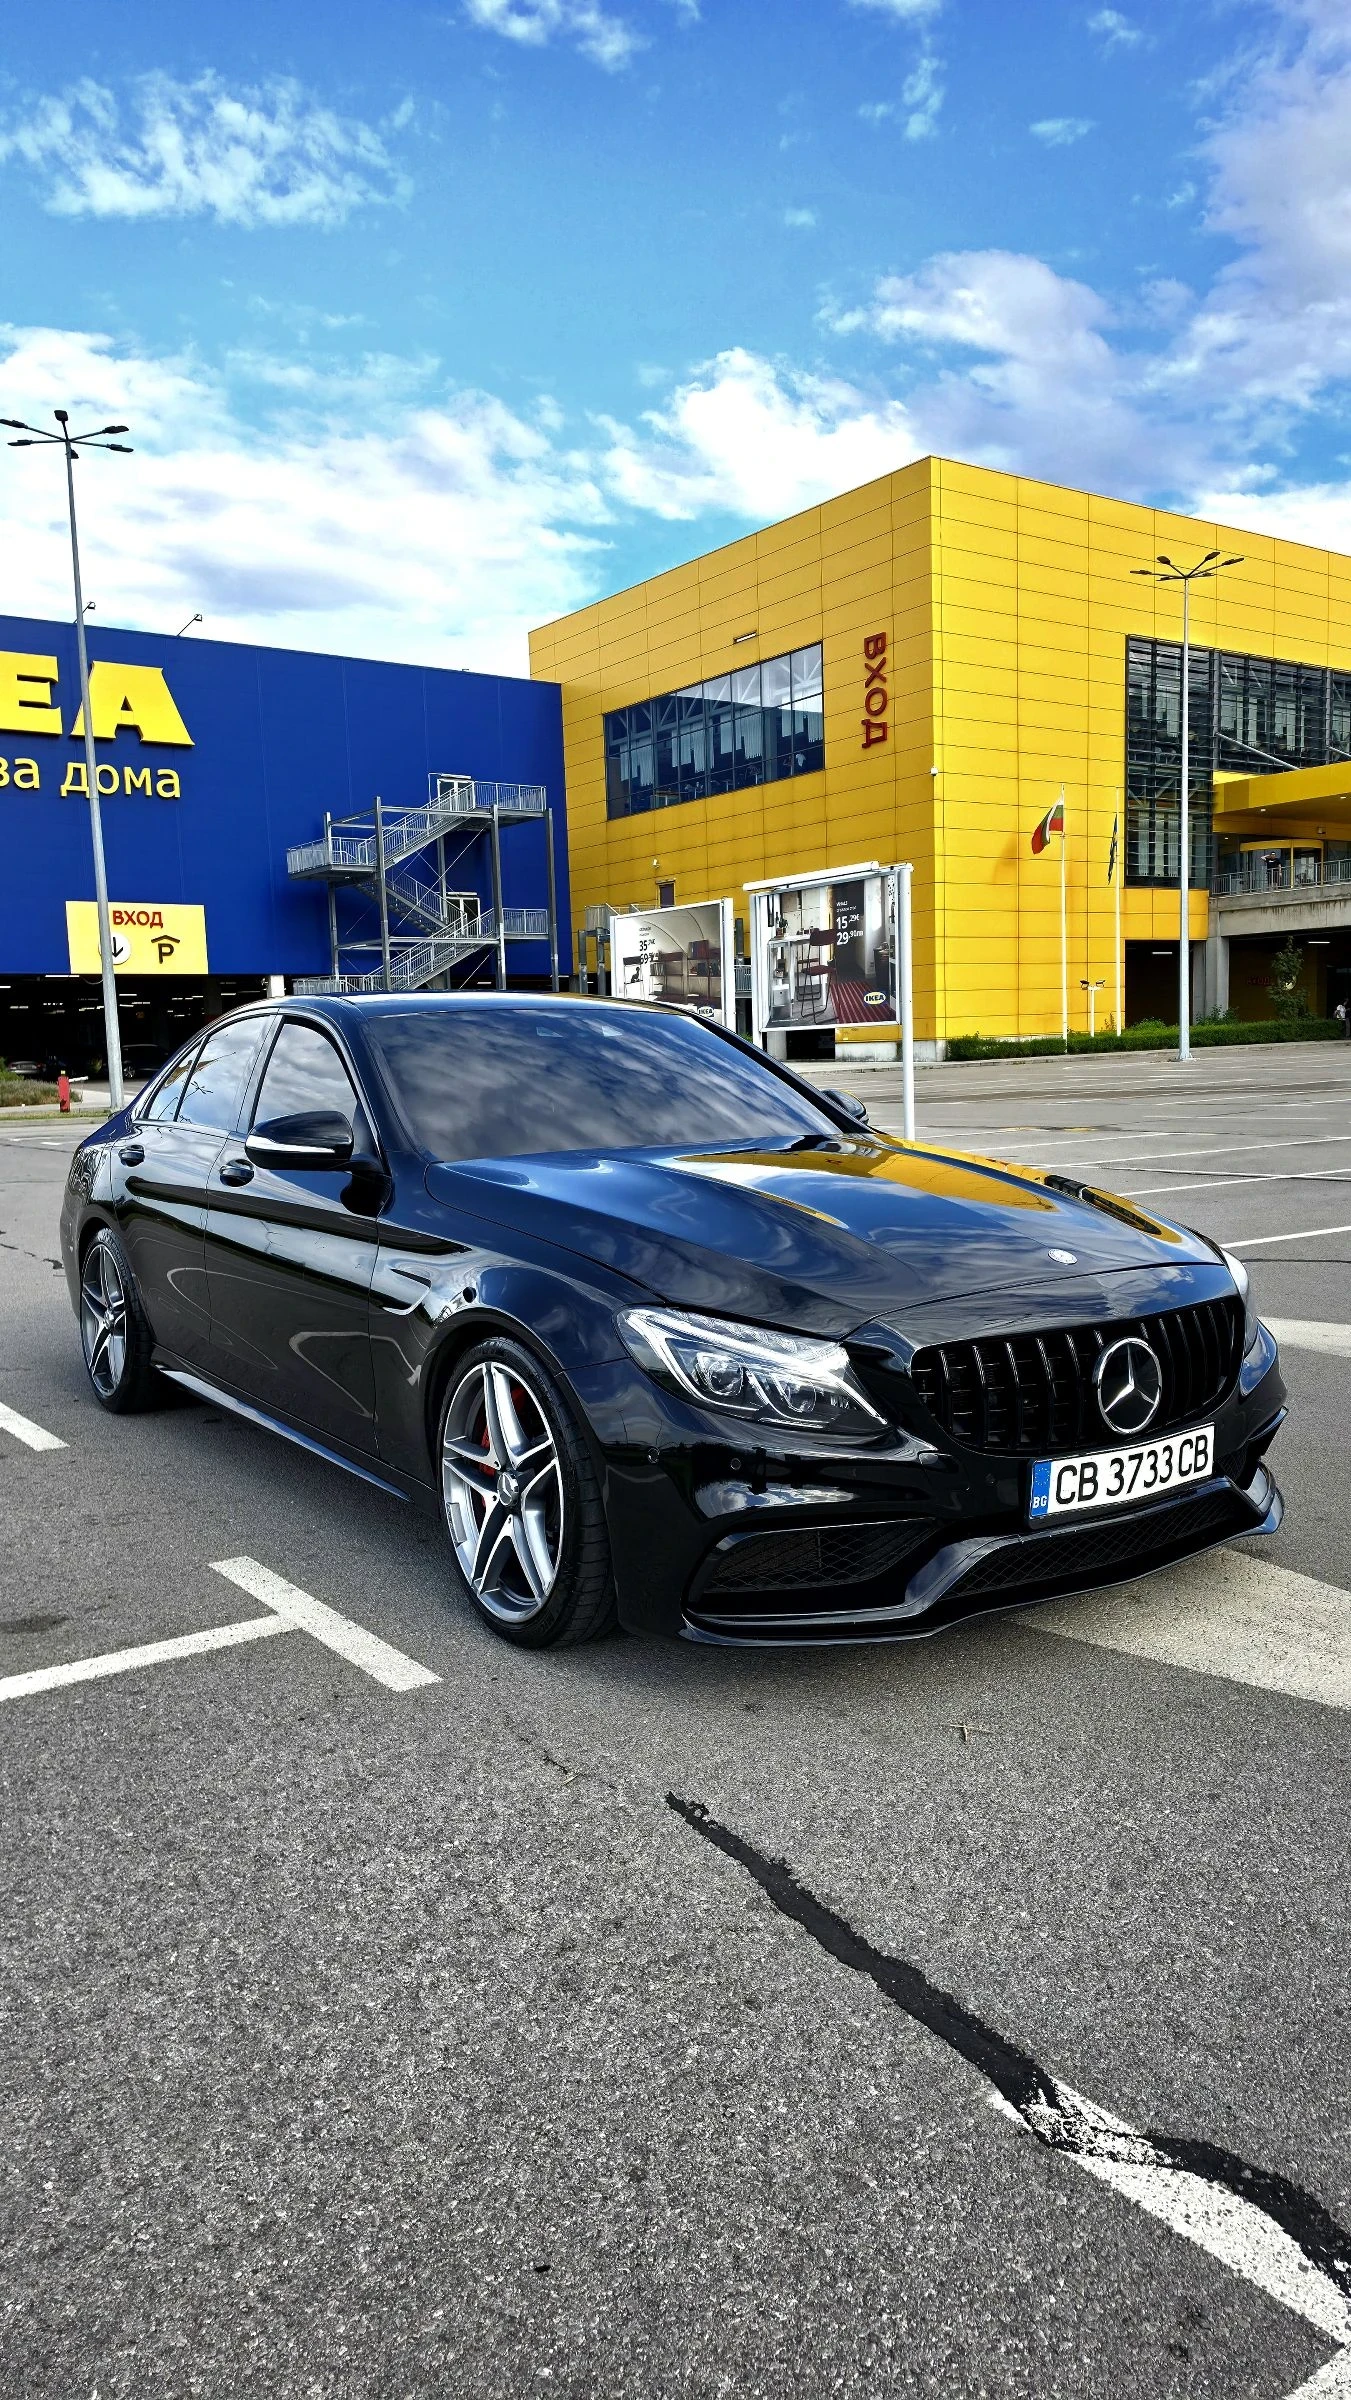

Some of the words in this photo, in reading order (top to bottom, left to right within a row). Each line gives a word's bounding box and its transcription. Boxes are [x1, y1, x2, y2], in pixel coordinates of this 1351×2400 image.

[861, 632, 887, 748] ВХОД
[60, 761, 181, 798] дома
[112, 910, 164, 928] ВХОД
[865, 994, 885, 1002] IKEA
[1055, 1461, 1098, 1505] CB
[1106, 1445, 1174, 1497] 3733
[1178, 1434, 1209, 1477] CB
[1032, 1495, 1047, 1509] BG
